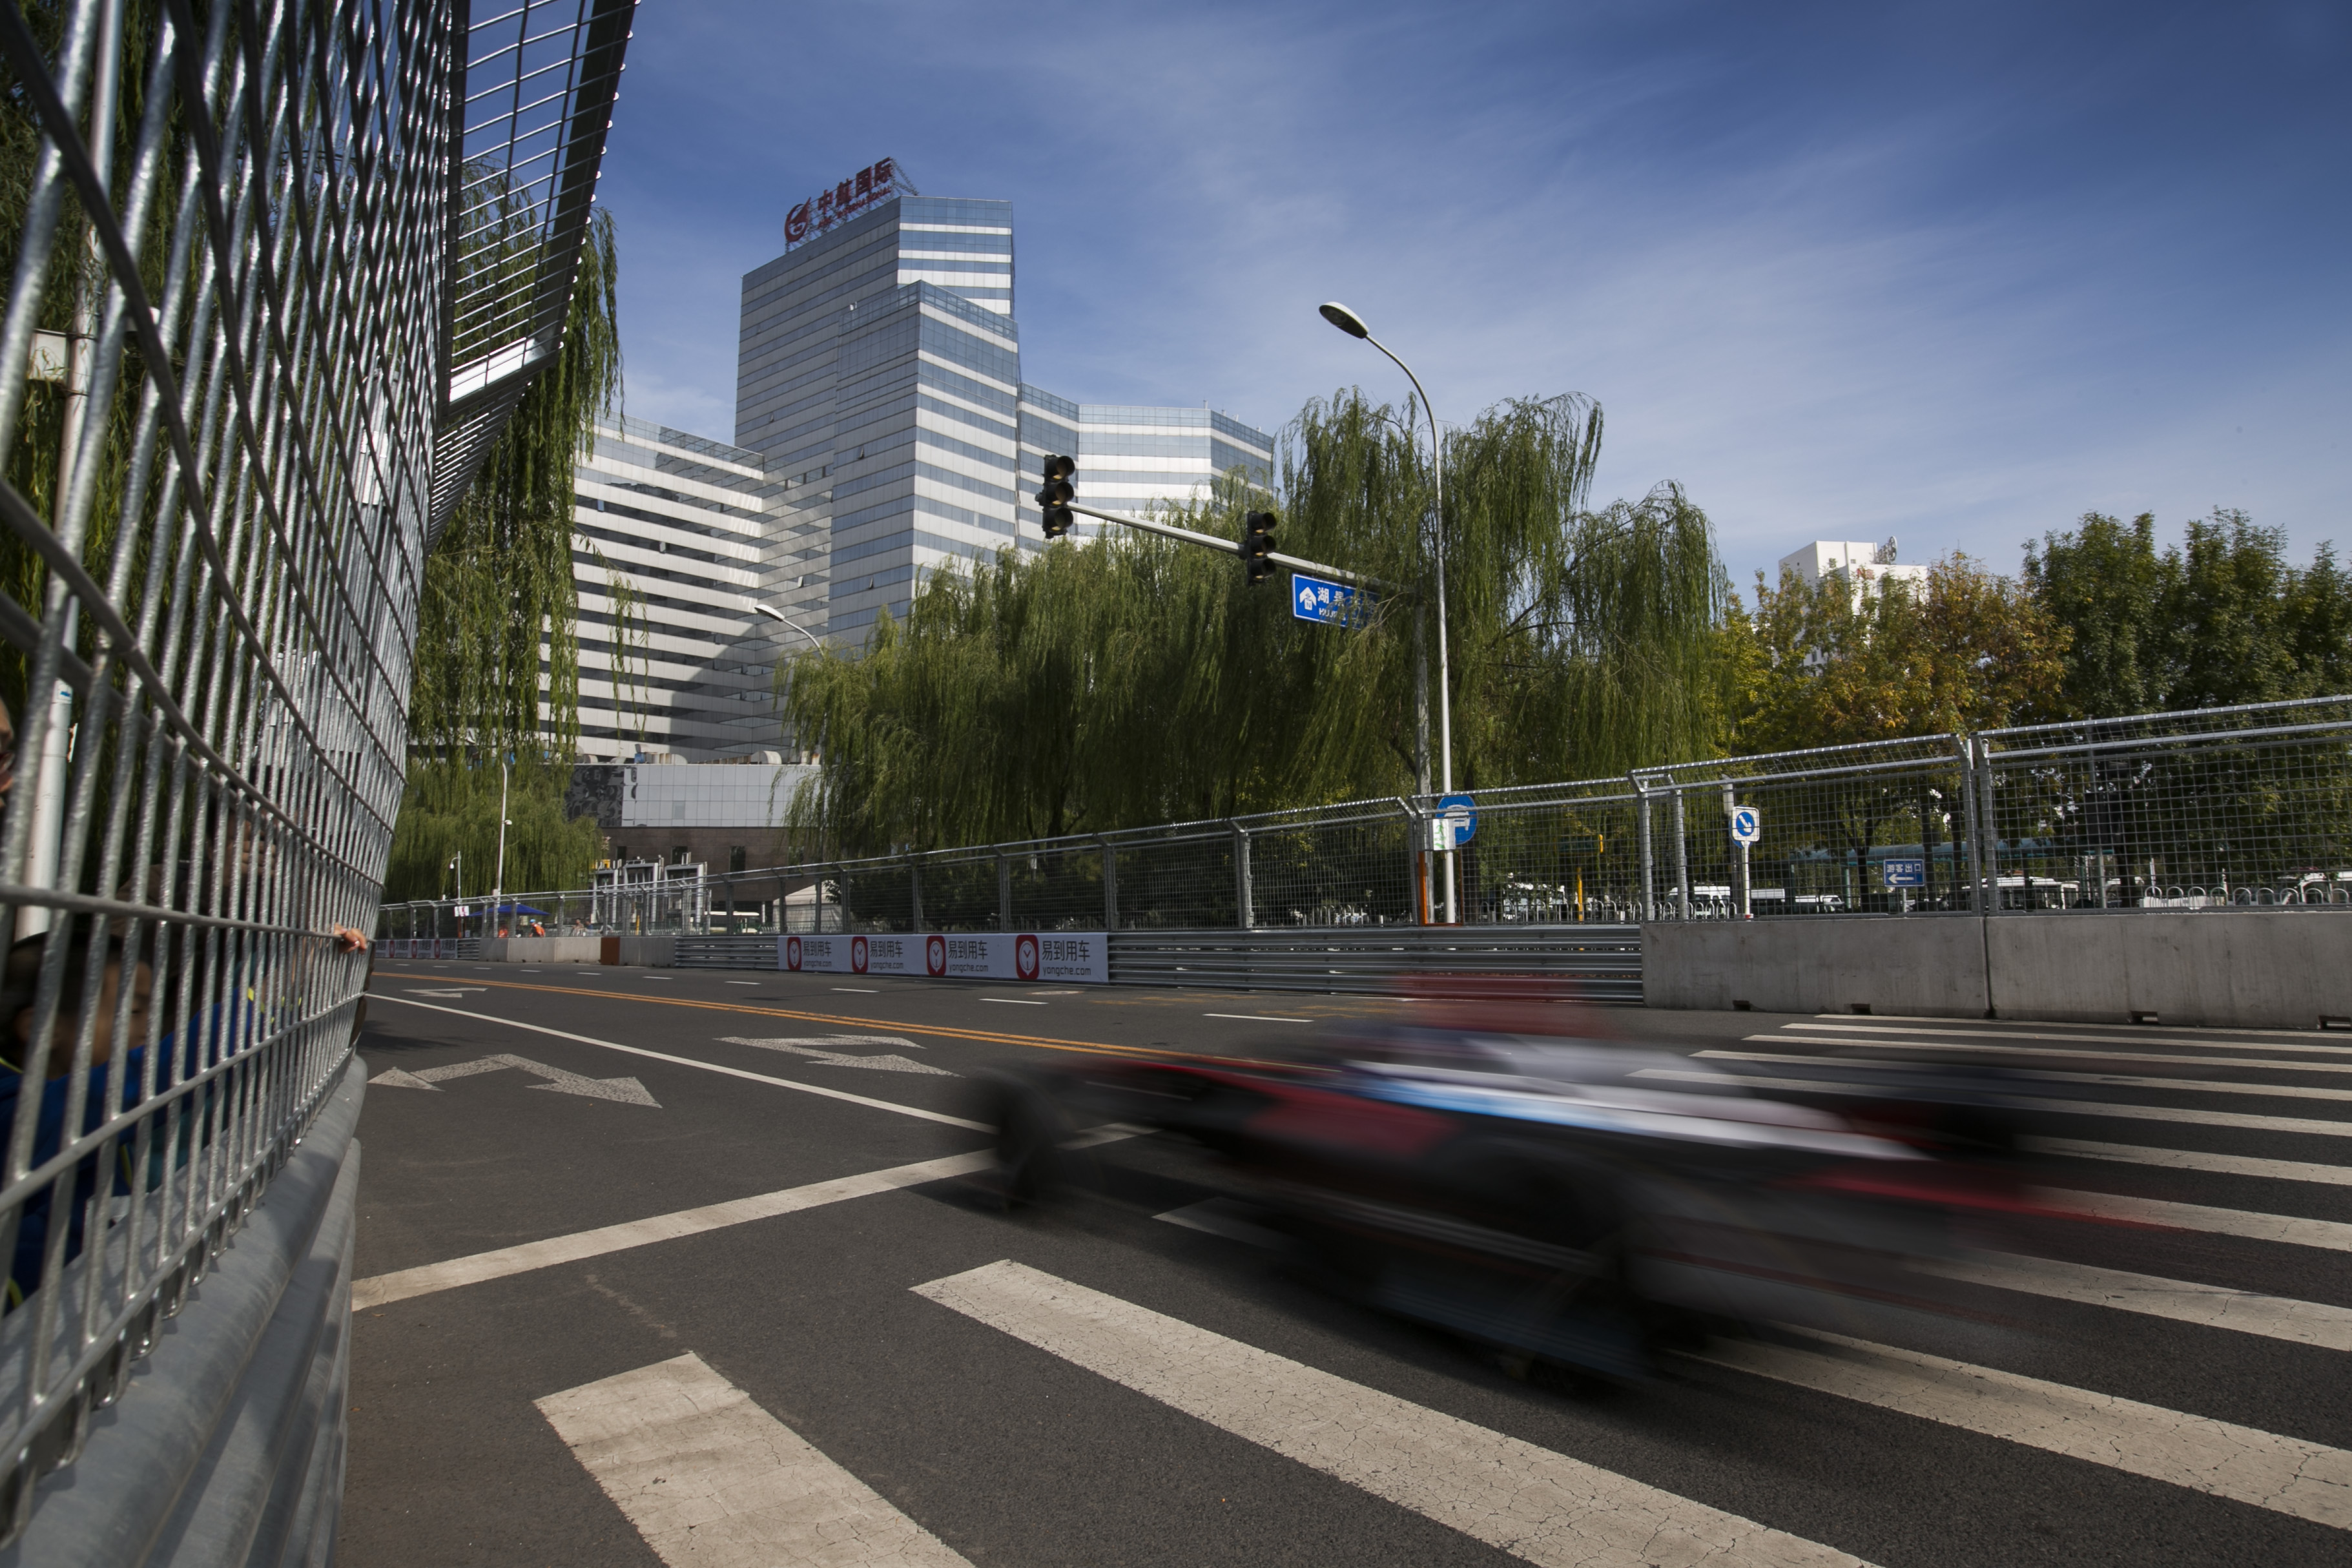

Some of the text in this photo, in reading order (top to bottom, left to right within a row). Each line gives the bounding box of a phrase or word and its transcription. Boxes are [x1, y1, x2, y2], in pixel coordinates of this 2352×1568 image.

[818, 157, 892, 214] 中航国际
[1886, 863, 1921, 872] 游客出口
[803, 940, 832, 956] 易到用车
[869, 940, 903, 958] 易到用车
[948, 940, 988, 960] 易到用车
[1042, 940, 1091, 962] 易到用车
[871, 961, 903, 970] yongche.com
[949, 963, 989, 973] yongche.com
[1043, 965, 1091, 976] yongche.com
